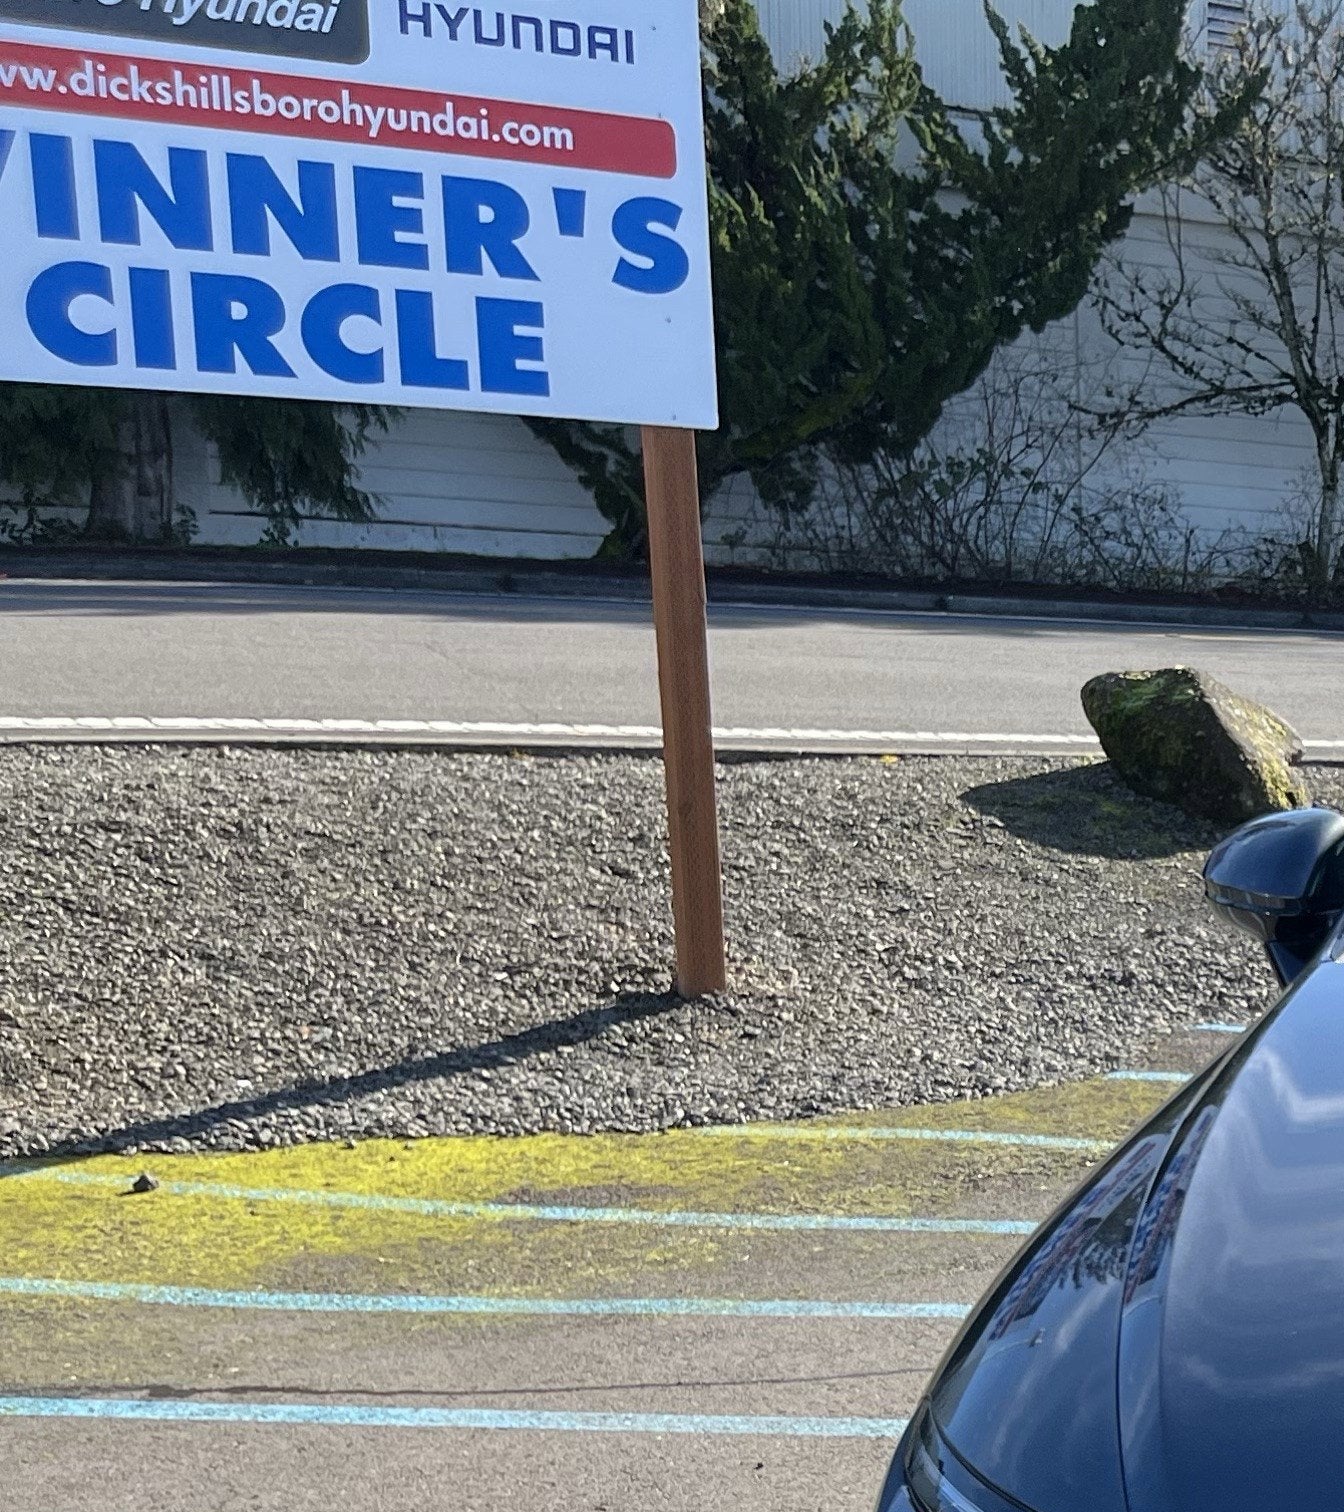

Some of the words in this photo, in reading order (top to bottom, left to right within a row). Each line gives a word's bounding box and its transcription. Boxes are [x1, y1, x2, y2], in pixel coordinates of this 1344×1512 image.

[139, 0, 341, 33] yundai
[399, 0, 635, 64] HYUNDAI
[0, 130, 689, 294] INNER'S
[26, 261, 550, 397] CIRCLE
